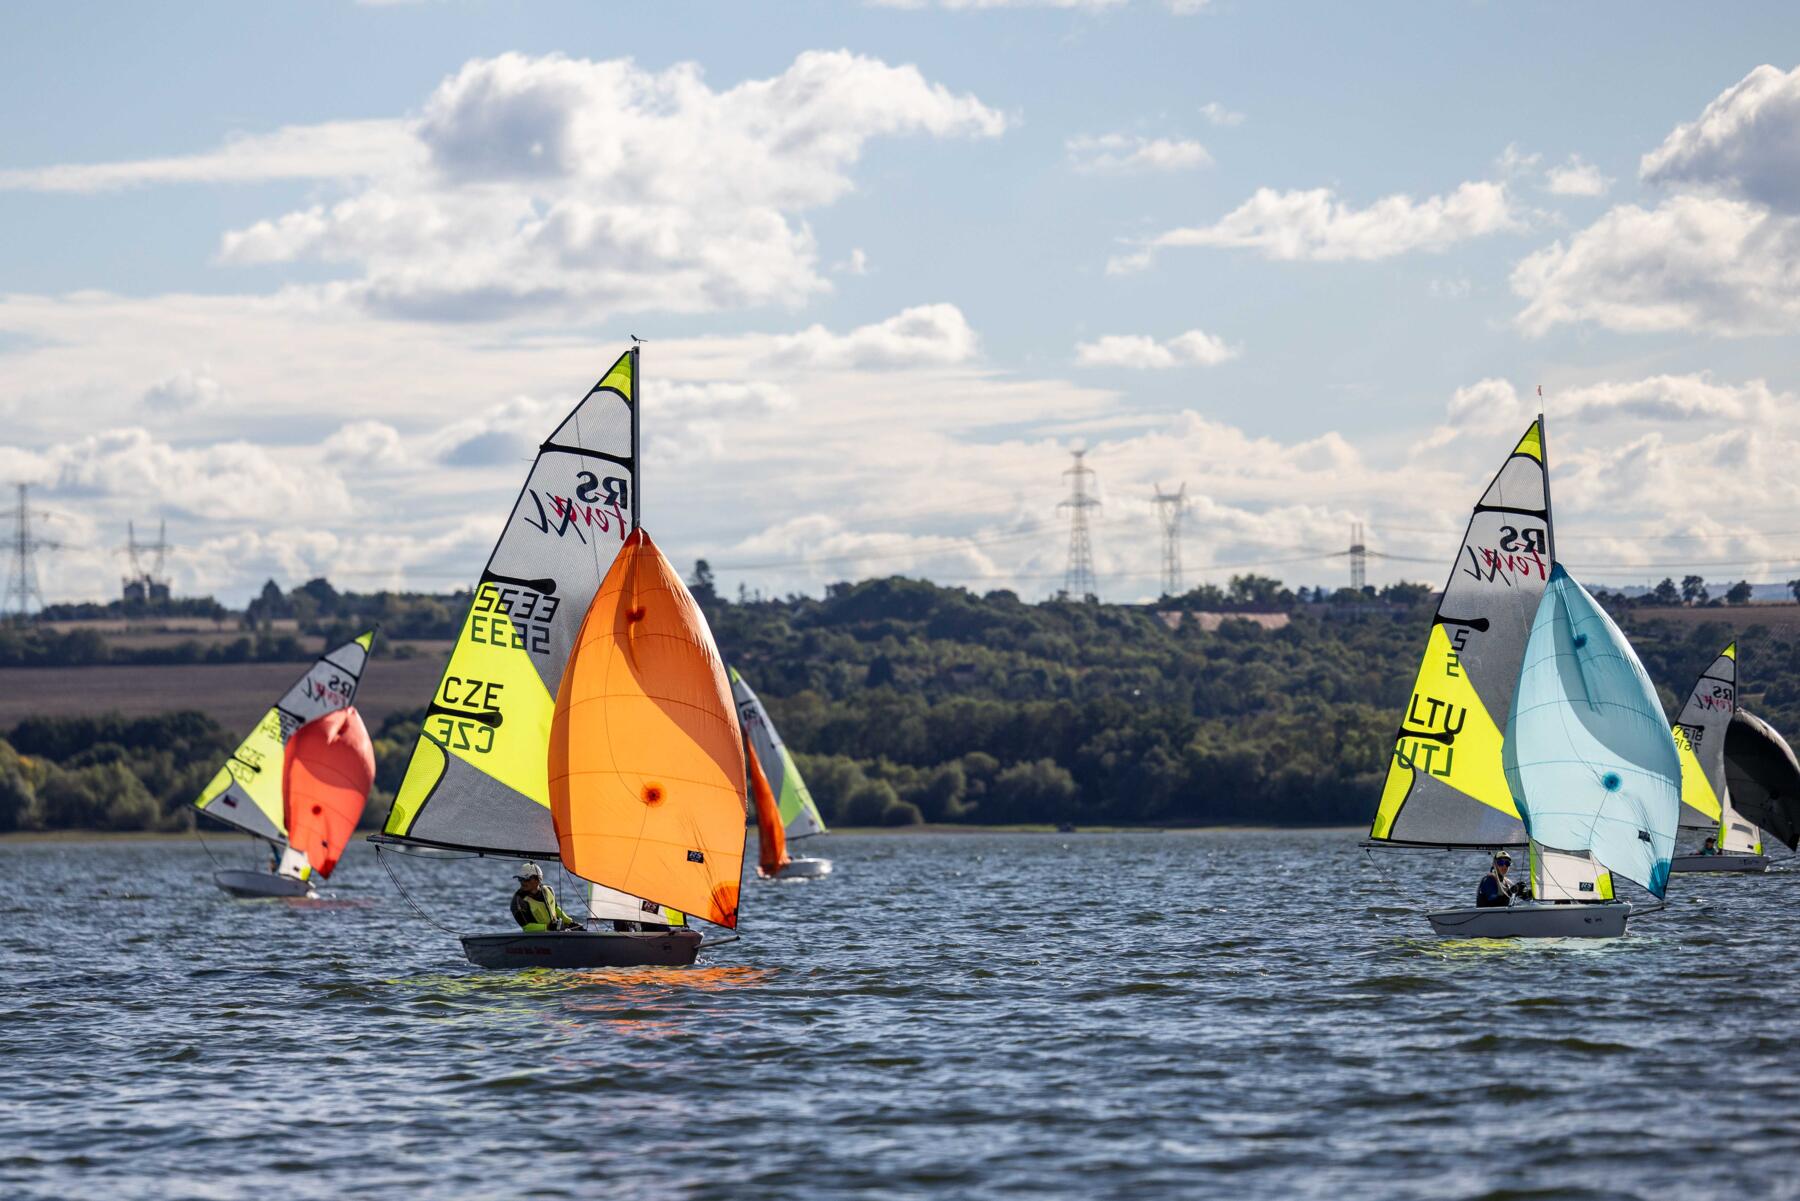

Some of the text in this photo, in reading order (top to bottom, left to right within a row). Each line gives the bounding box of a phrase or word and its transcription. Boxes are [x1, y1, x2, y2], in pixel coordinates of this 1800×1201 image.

[475, 586, 560, 623] 5633
[1451, 629, 1469, 651] 5
[443, 676, 504, 712] CZE
[1408, 694, 1466, 735] LTU
[1674, 726, 1703, 741] 7618
